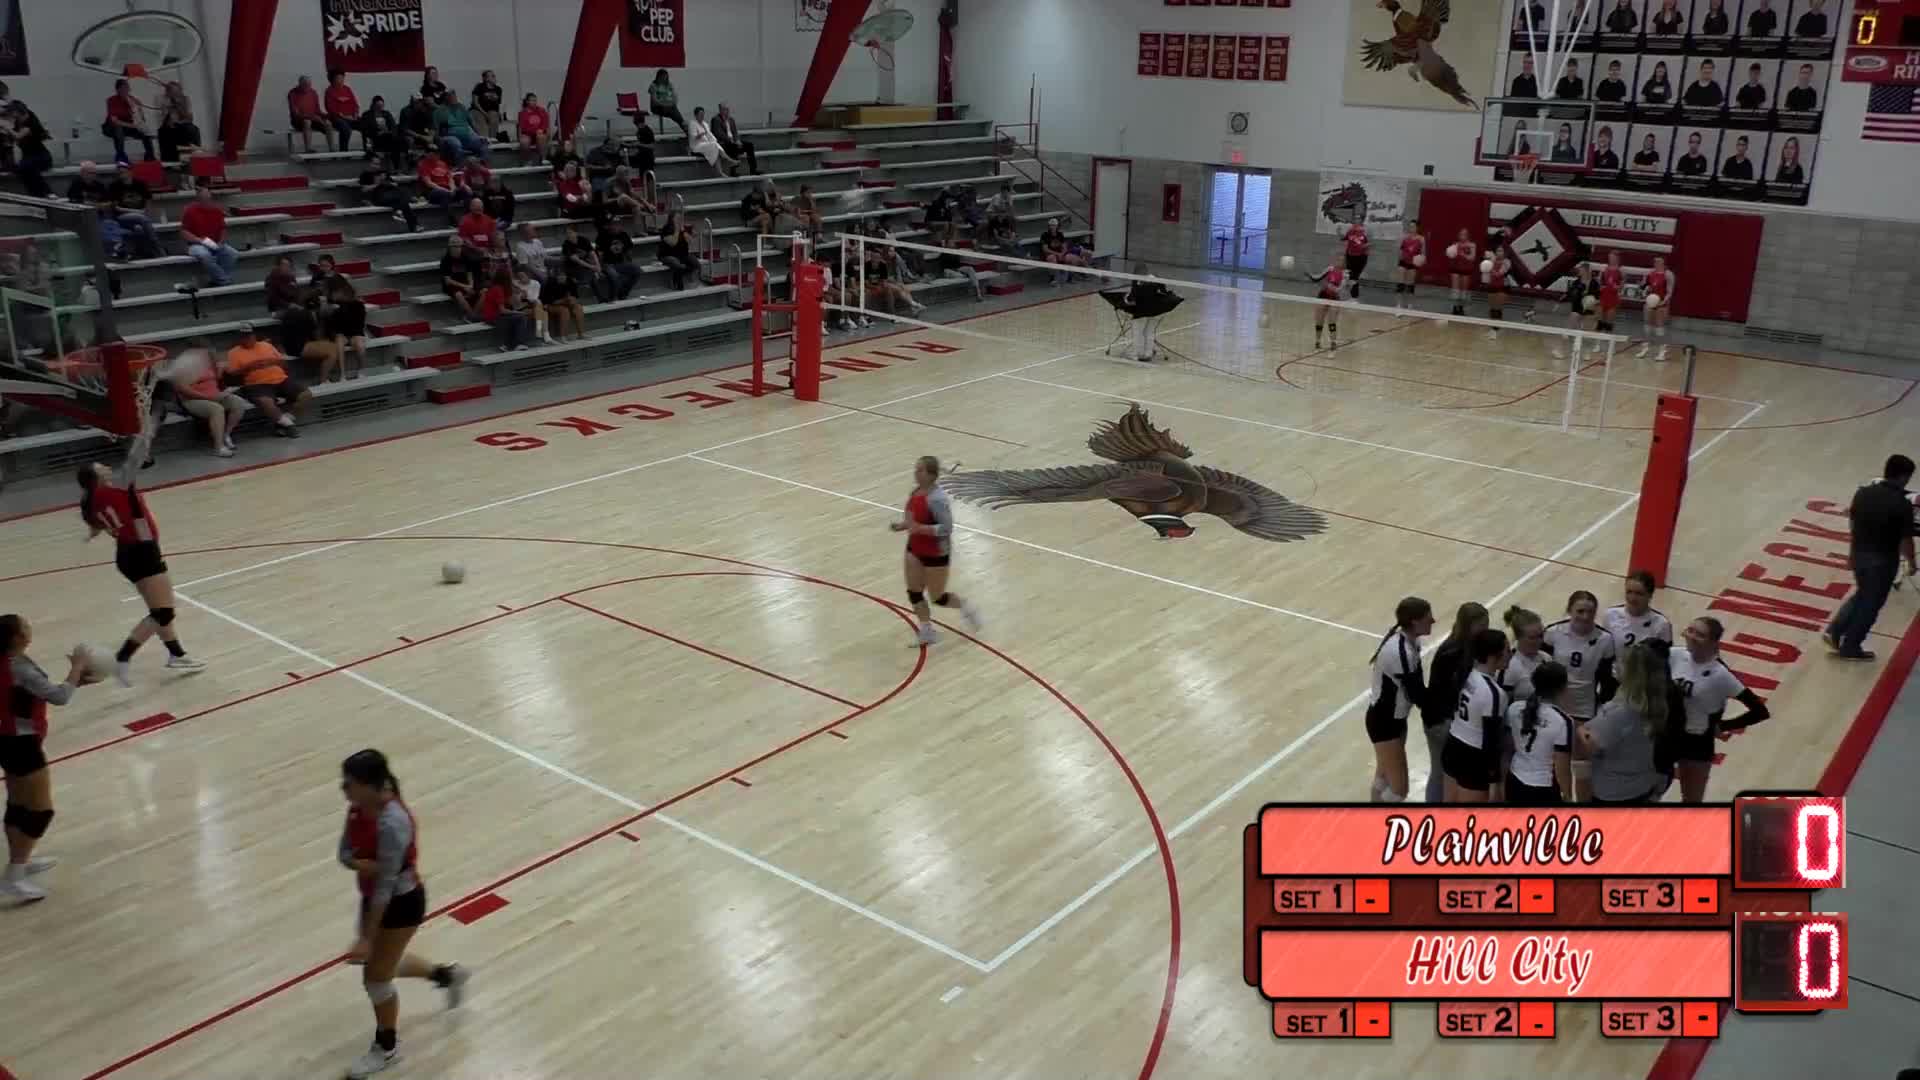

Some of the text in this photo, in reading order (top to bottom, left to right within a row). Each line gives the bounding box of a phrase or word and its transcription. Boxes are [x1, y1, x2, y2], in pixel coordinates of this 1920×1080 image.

[362, 10, 422, 32] PRIDE
[649, 8, 674, 25] PEP
[641, 26, 675, 43] CLUB
[1857, 15, 1877, 44] 0
[1580, 213, 1660, 232] HILL CITY
[1571, 651, 1583, 668] 9
